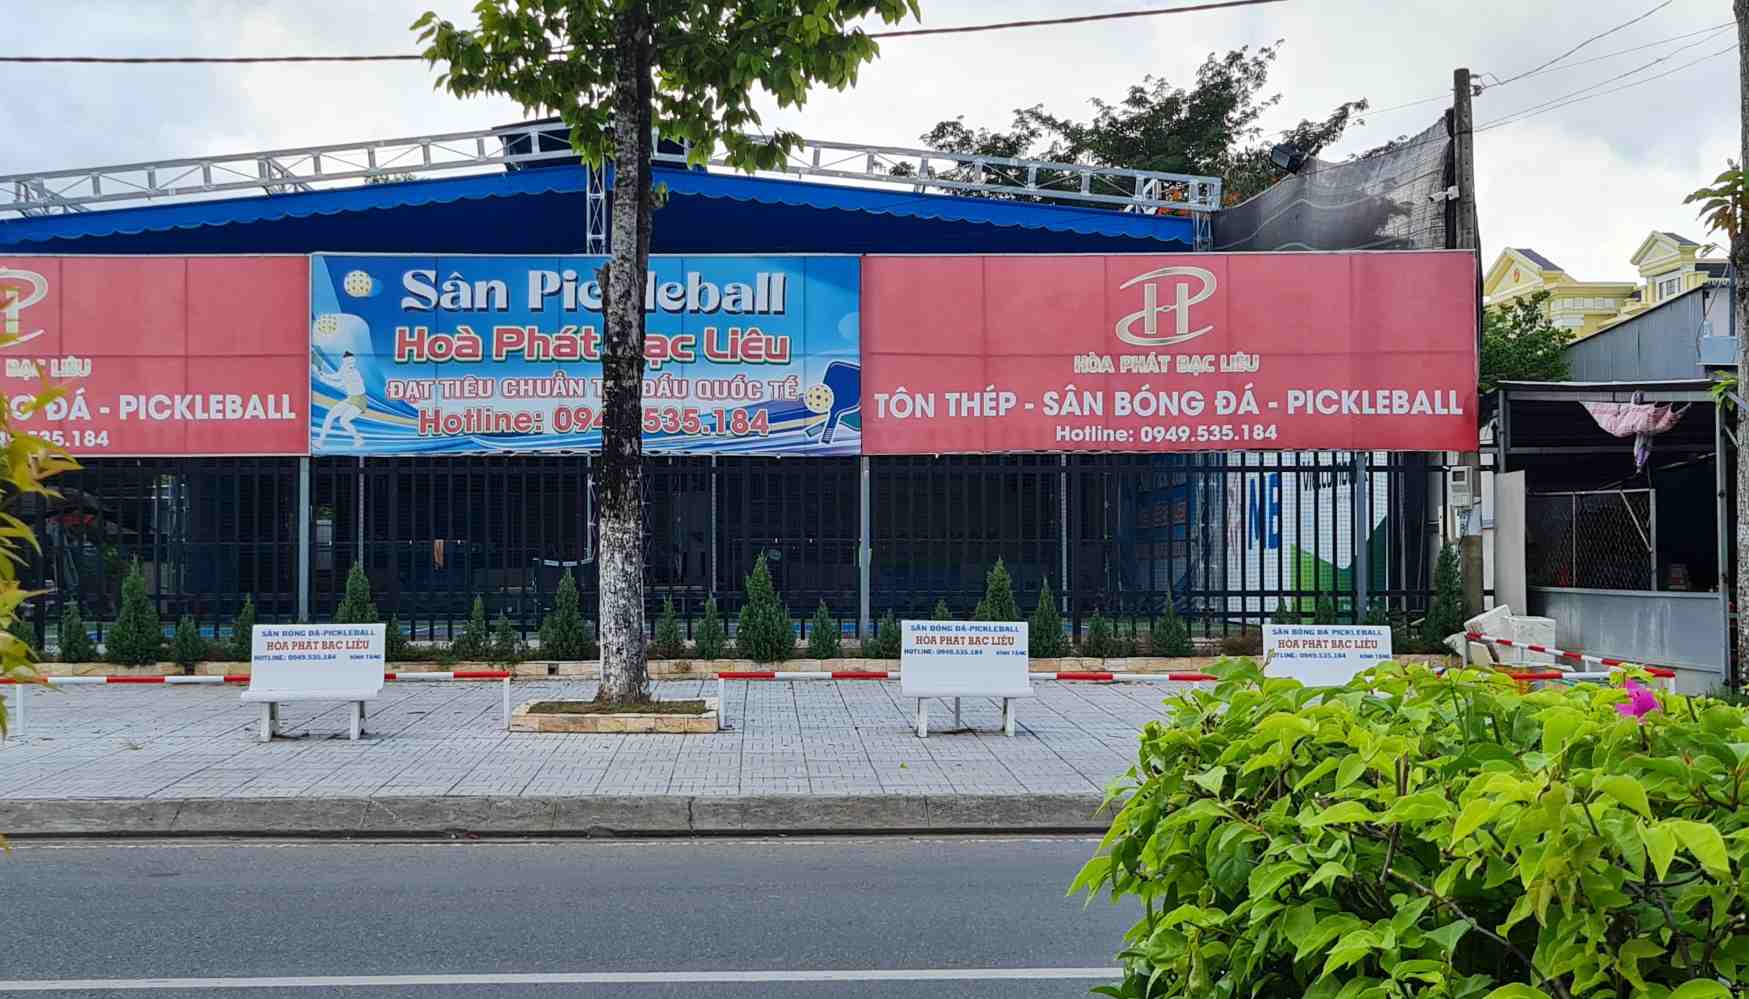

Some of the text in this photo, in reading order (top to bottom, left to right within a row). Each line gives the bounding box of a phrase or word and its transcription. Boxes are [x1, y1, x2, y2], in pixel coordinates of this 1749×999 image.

[400, 269, 786, 313] Sân Picleball
[394, 325, 791, 369] Hoà Phát ạc Liêu
[1073, 352, 1260, 375] HÒA PHÁT BẠC LIÊU
[386, 377, 434, 404] ĐẠT
[440, 375, 495, 398] TIÊU
[502, 371, 585, 398] CHUẨN
[695, 374, 764, 400] QUỐC
[768, 375, 800, 401] TẾ
[873, 386, 936, 419] TÔN
[945, 384, 1017, 418] THÉP
[1042, 384, 1104, 417] SÂN
[1114, 384, 1205, 417] BÓNG
[1214, 383, 1260, 416] ĐÁ
[1287, 389, 1463, 416] PICKLEBALL
[119, 394, 296, 420] PICKLEBALL
[418, 405, 544, 436] Hotline:
[1056, 424, 1278, 443] Hotline: 0949.535.184
